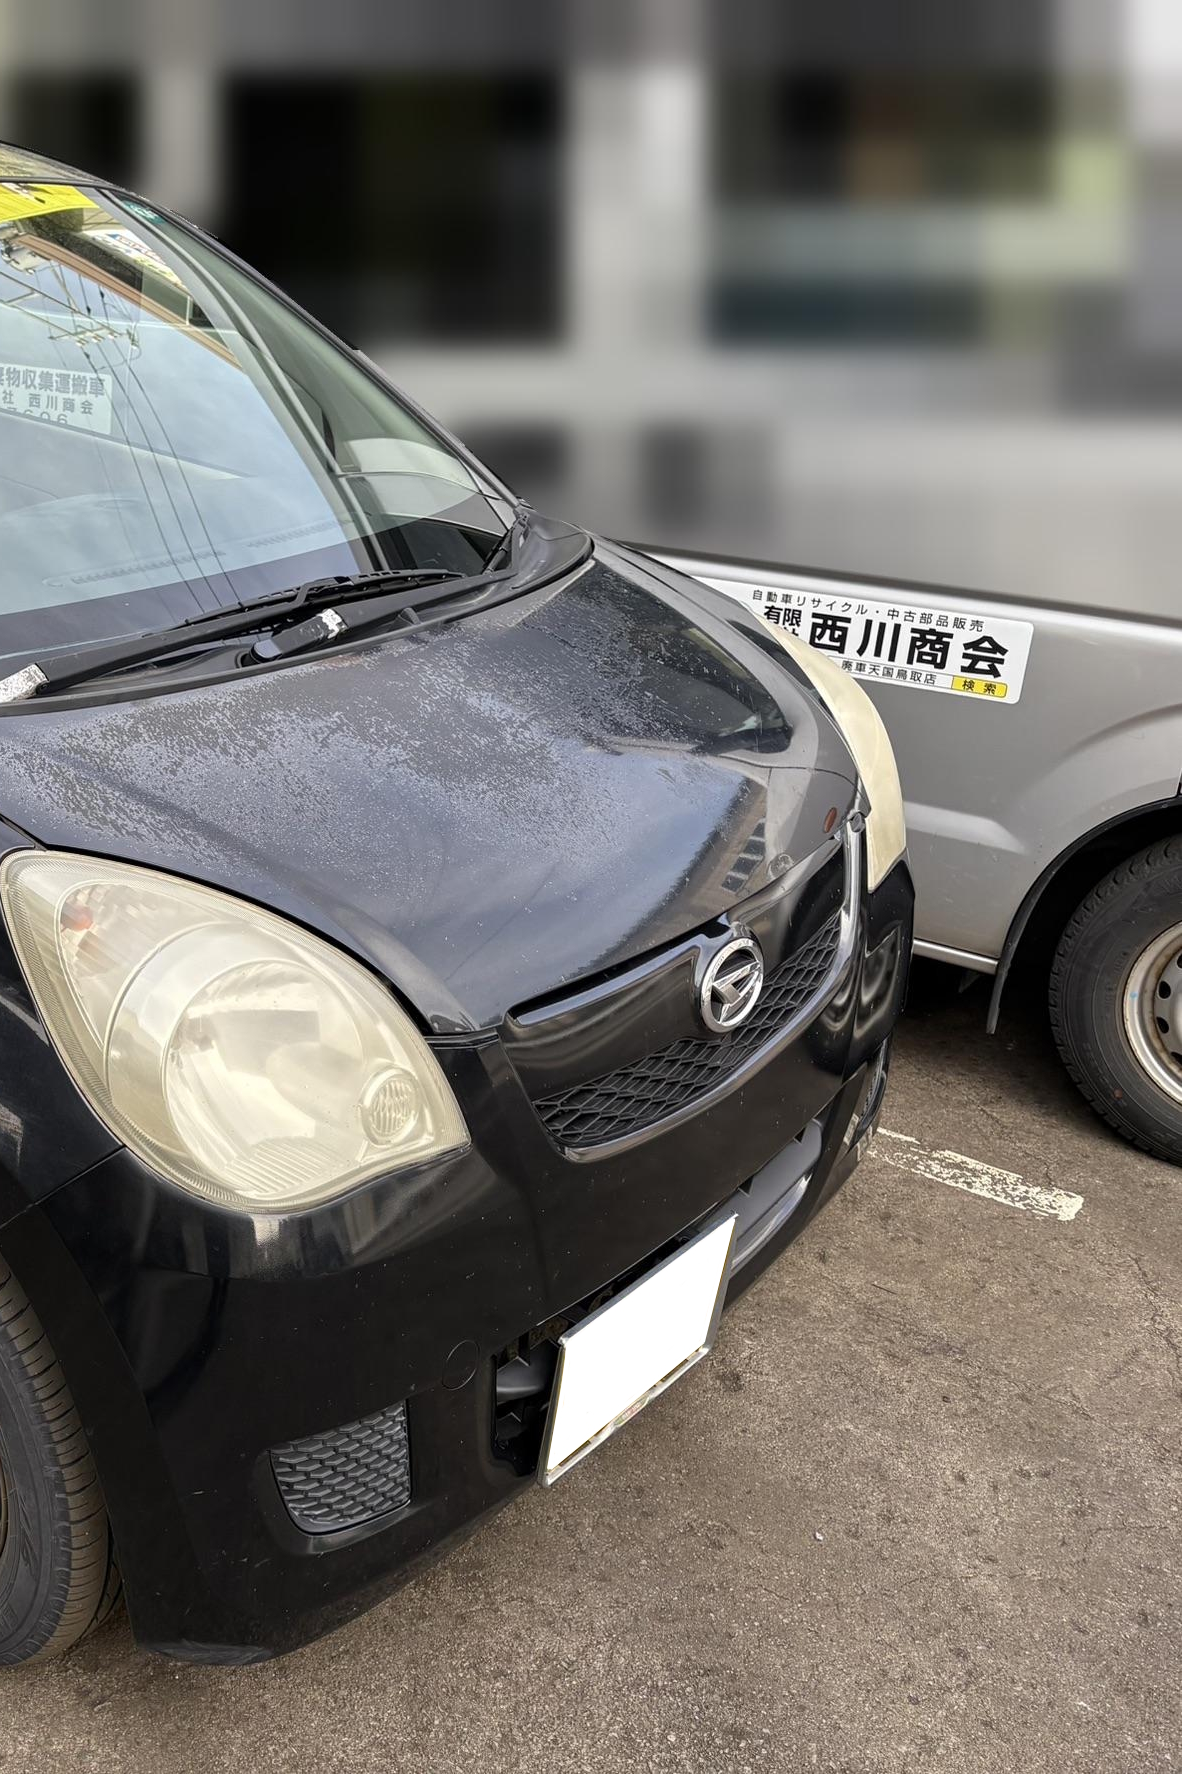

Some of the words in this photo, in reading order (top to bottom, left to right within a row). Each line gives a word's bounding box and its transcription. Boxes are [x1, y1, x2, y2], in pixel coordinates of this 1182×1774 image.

[28, 393, 94, 416] 西川商会
[752, 589, 985, 632] 自動車リサイクル・中古部品販売
[808, 611, 1009, 680] 西川商会
[841, 659, 937, 686] 廃車天国鳥取店
[961, 677, 998, 696] 検索
